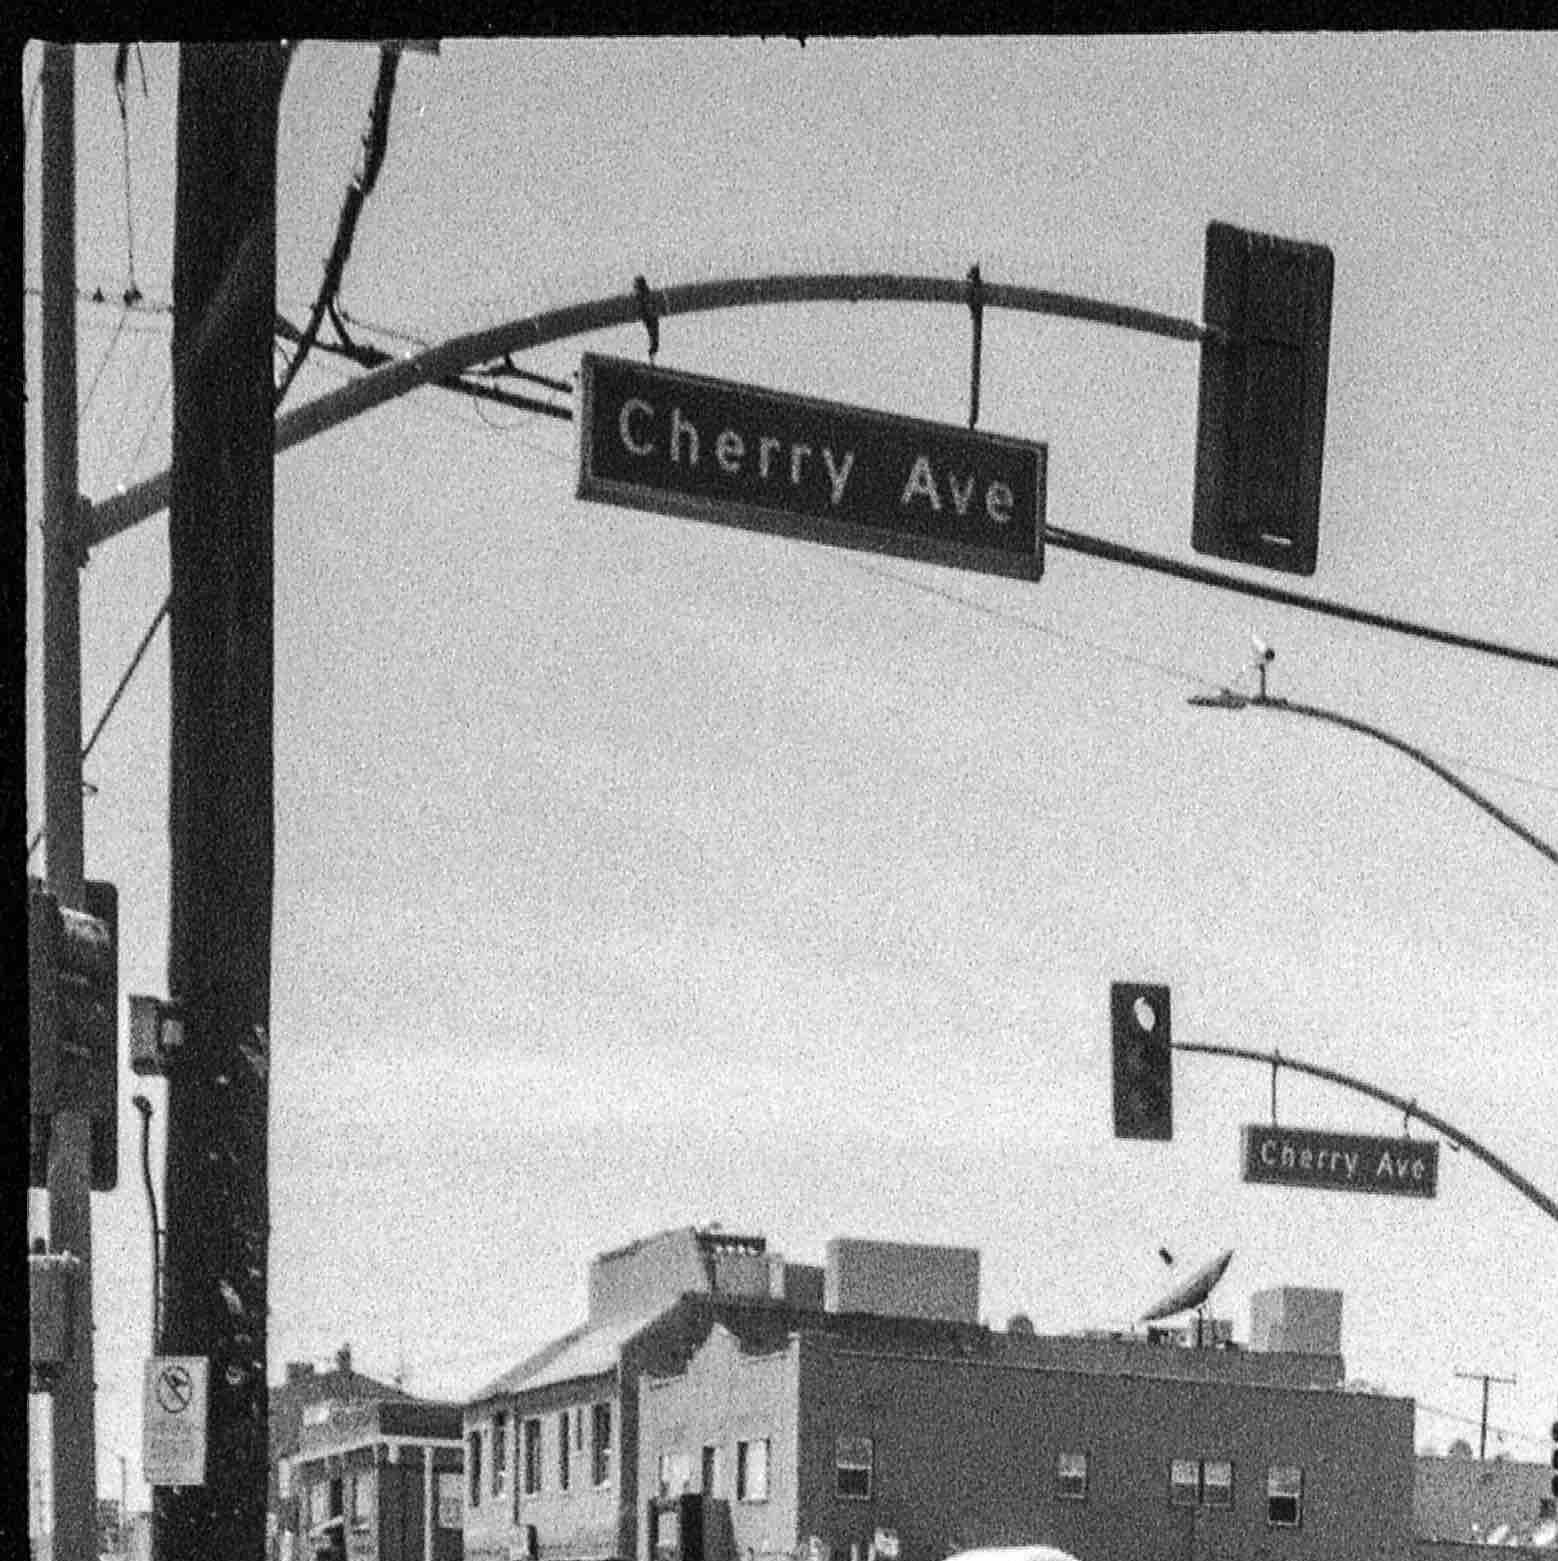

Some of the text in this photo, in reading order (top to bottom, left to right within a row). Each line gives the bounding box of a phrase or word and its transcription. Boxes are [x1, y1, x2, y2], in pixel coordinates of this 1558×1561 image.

[619, 398, 1014, 523] Cherry Ave
[1261, 1140, 1425, 1179] Cherry Ave
